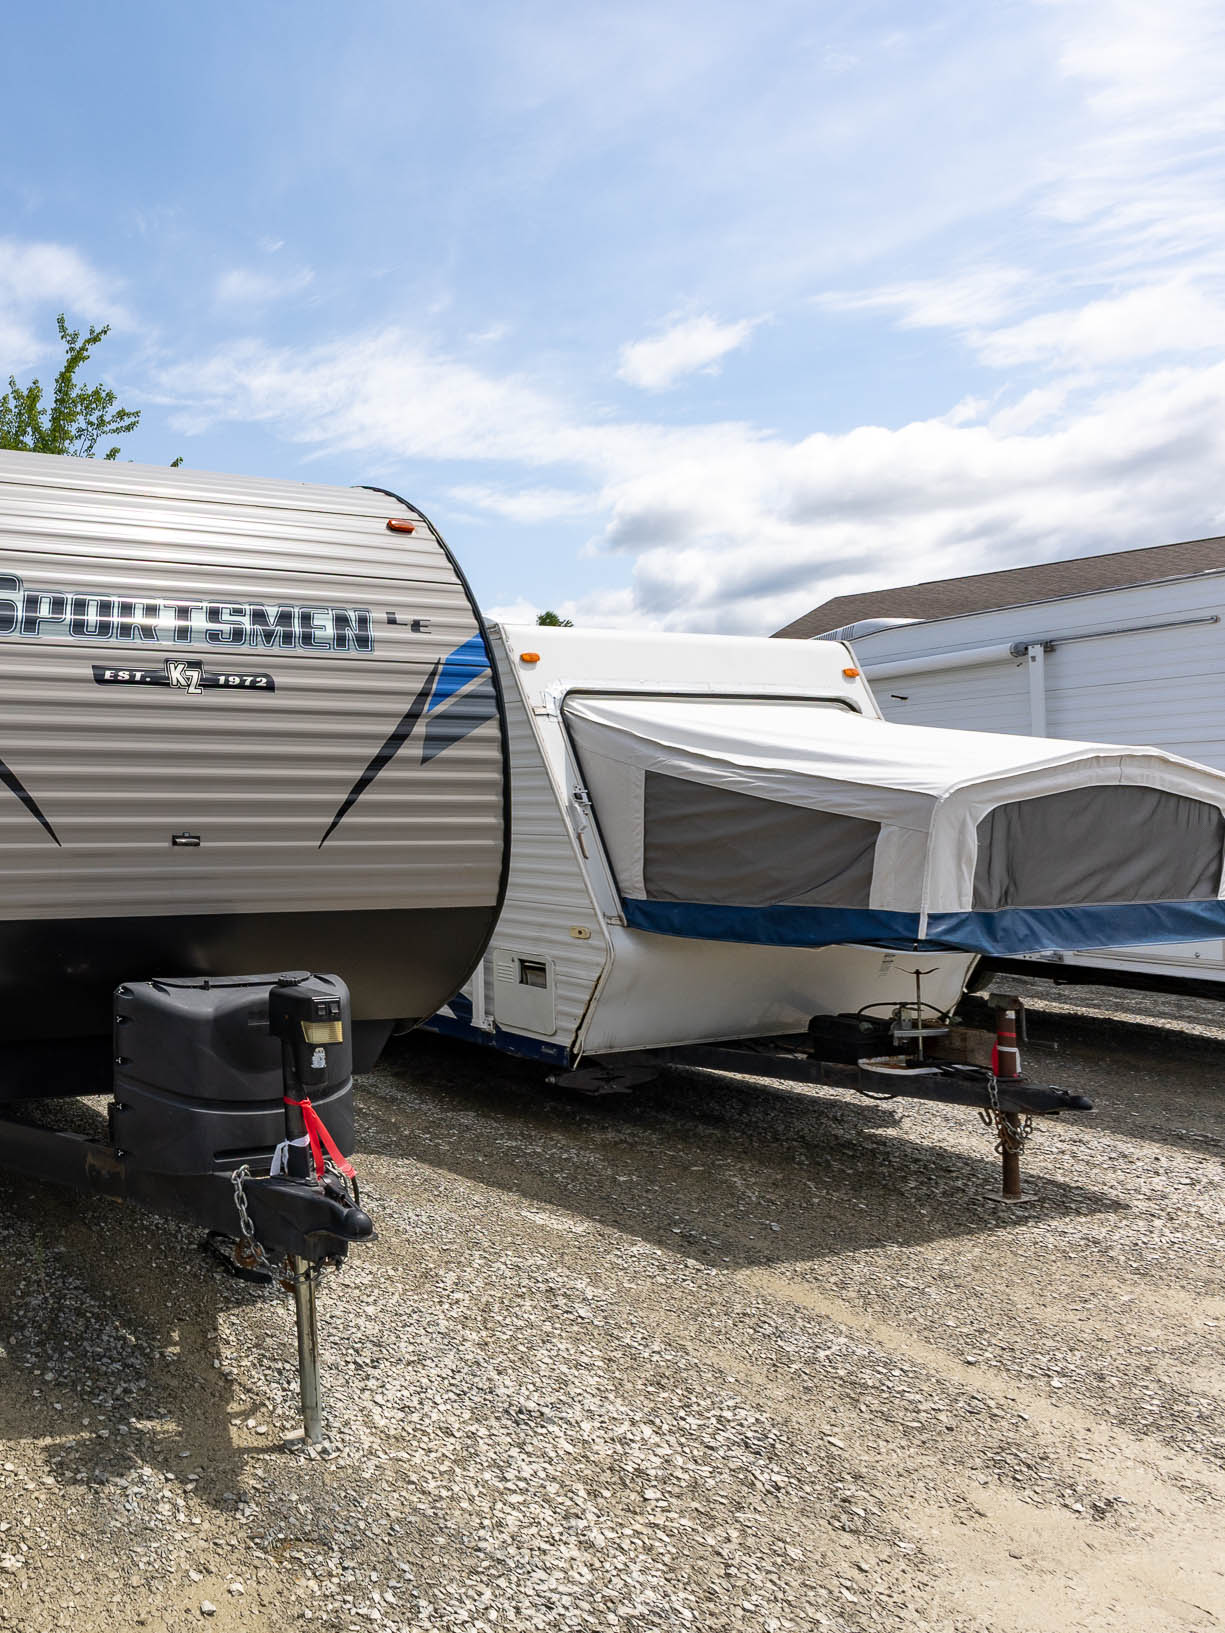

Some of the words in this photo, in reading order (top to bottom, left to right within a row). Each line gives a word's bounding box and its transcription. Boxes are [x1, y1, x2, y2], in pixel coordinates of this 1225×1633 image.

[385, 610, 432, 634] LE
[104, 669, 151, 682] EST.
[167, 661, 203, 695] KZ
[217, 675, 268, 687] 1972
